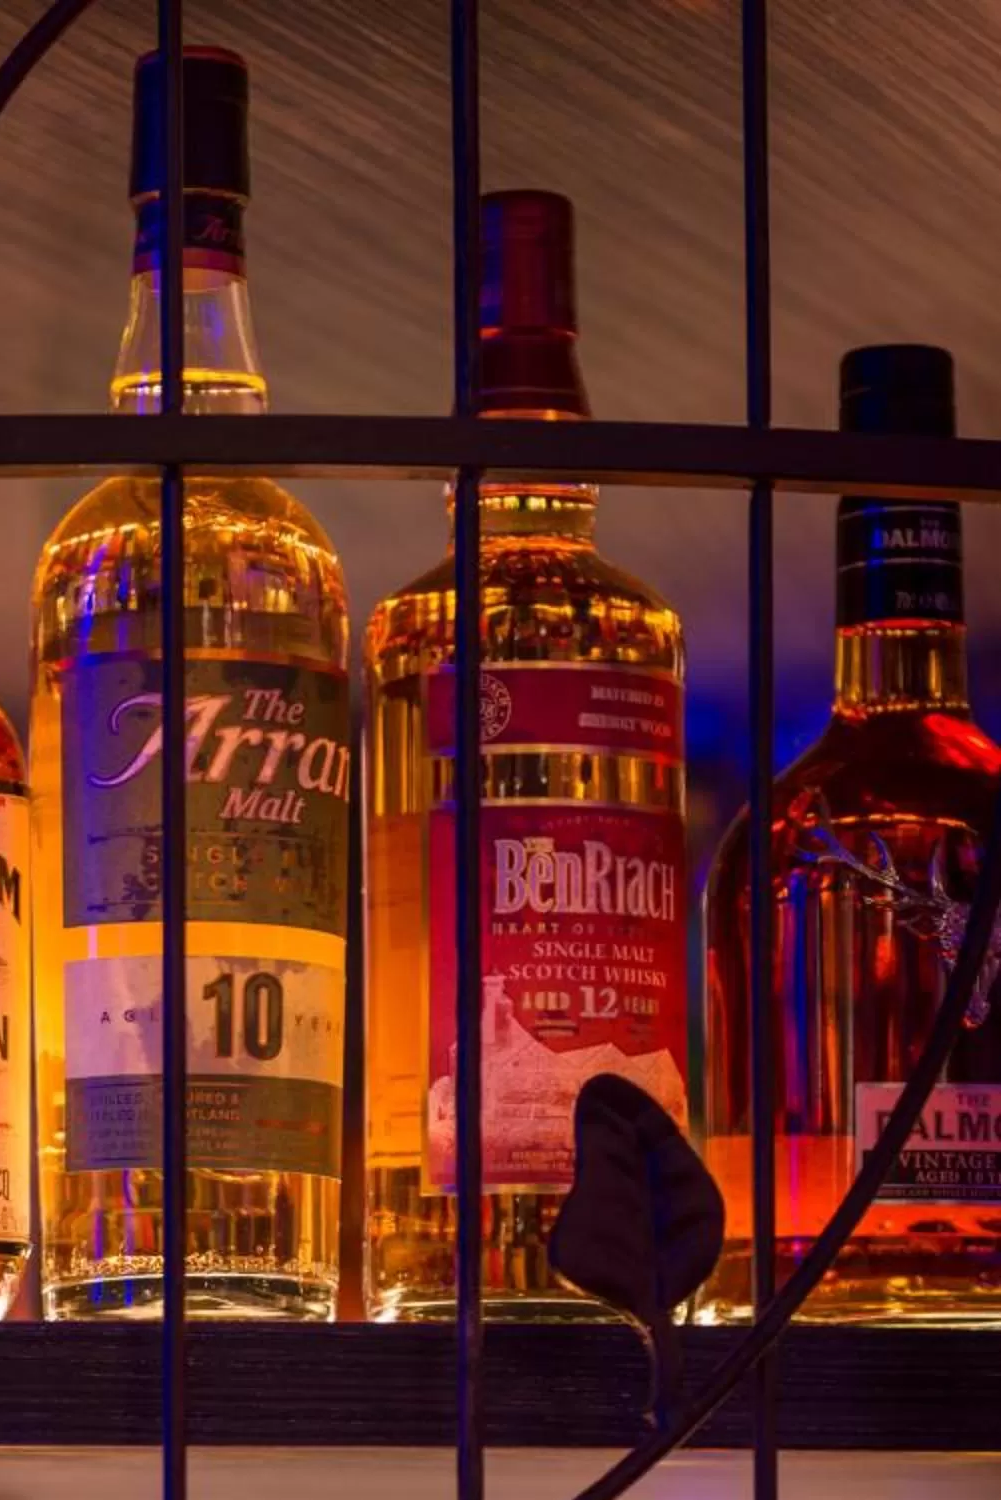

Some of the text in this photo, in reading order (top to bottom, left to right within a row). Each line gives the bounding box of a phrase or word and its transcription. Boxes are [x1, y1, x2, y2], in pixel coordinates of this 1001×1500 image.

[242, 688, 305, 726] The
[218, 787, 306, 824] Malt
[532, 941, 655, 963] SINGLE MALT
[507, 963, 668, 988] SCOTCH WHISKY
[203, 972, 284, 1060] 10
[579, 986, 619, 1018] 12
[899, 1150, 997, 1170] VINTAGE
